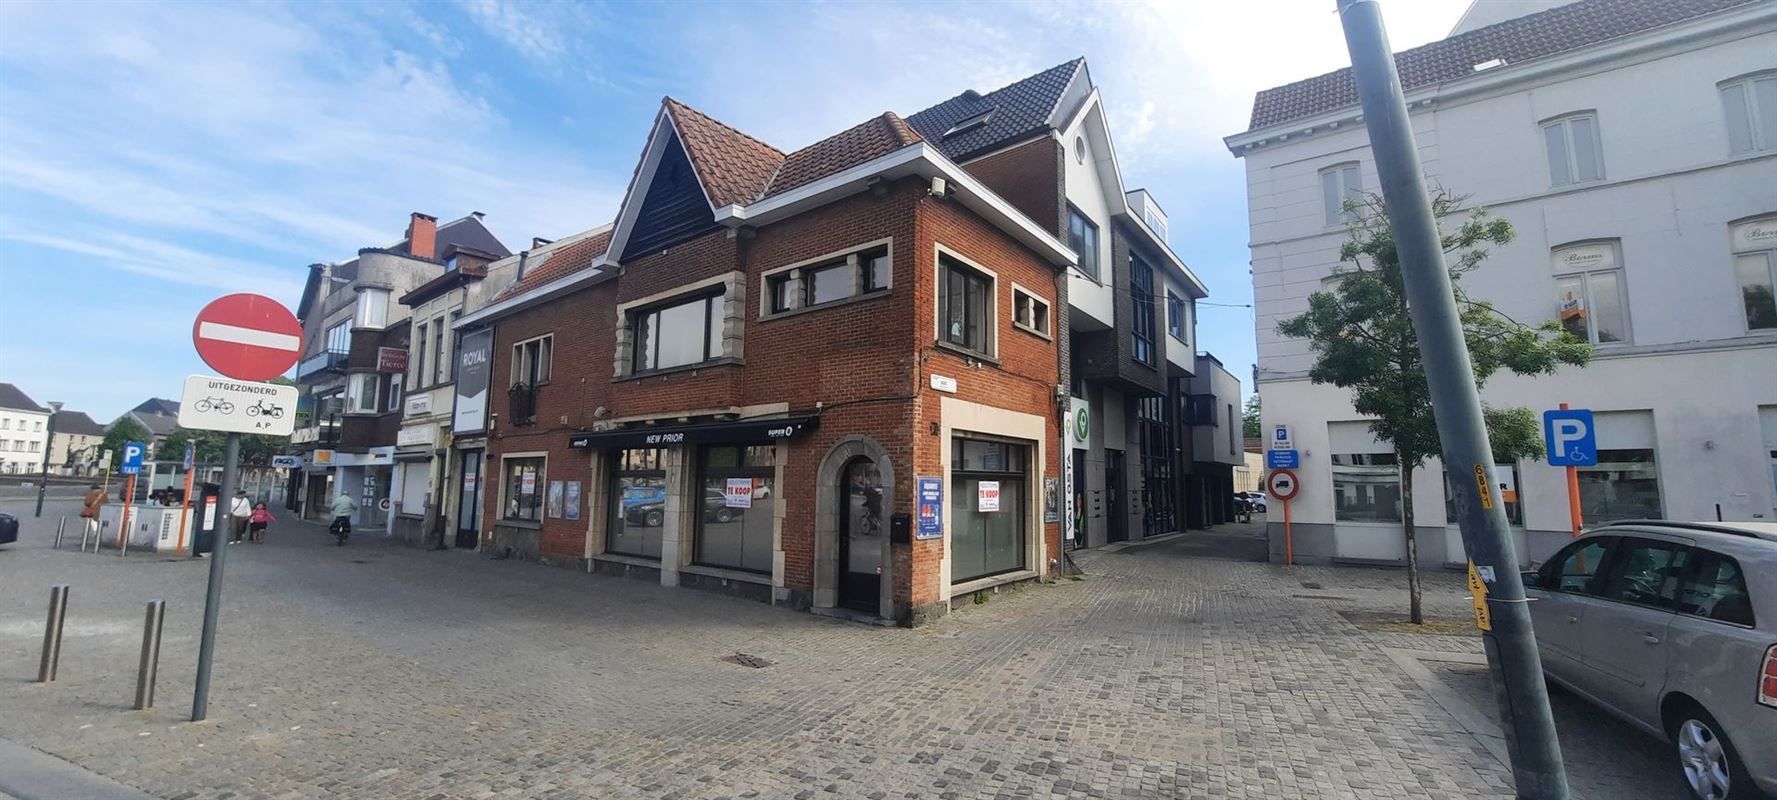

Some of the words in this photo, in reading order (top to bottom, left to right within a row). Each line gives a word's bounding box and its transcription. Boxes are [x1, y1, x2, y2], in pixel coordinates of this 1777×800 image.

[463, 348, 486, 367] ROYAL
[208, 381, 278, 396] UITGEZONDERD
[646, 434, 662, 444] NEW
[662, 433, 684, 443] PRIOR
[1278, 430, 1285, 439] P
[1552, 418, 1587, 457] P
[125, 446, 140, 463] P
[124, 466, 139, 474] TAXI
[727, 486, 734, 495] TE
[734, 486, 750, 496] KOOP
[979, 489, 985, 498] TE
[985, 489, 998, 498] KOOP
